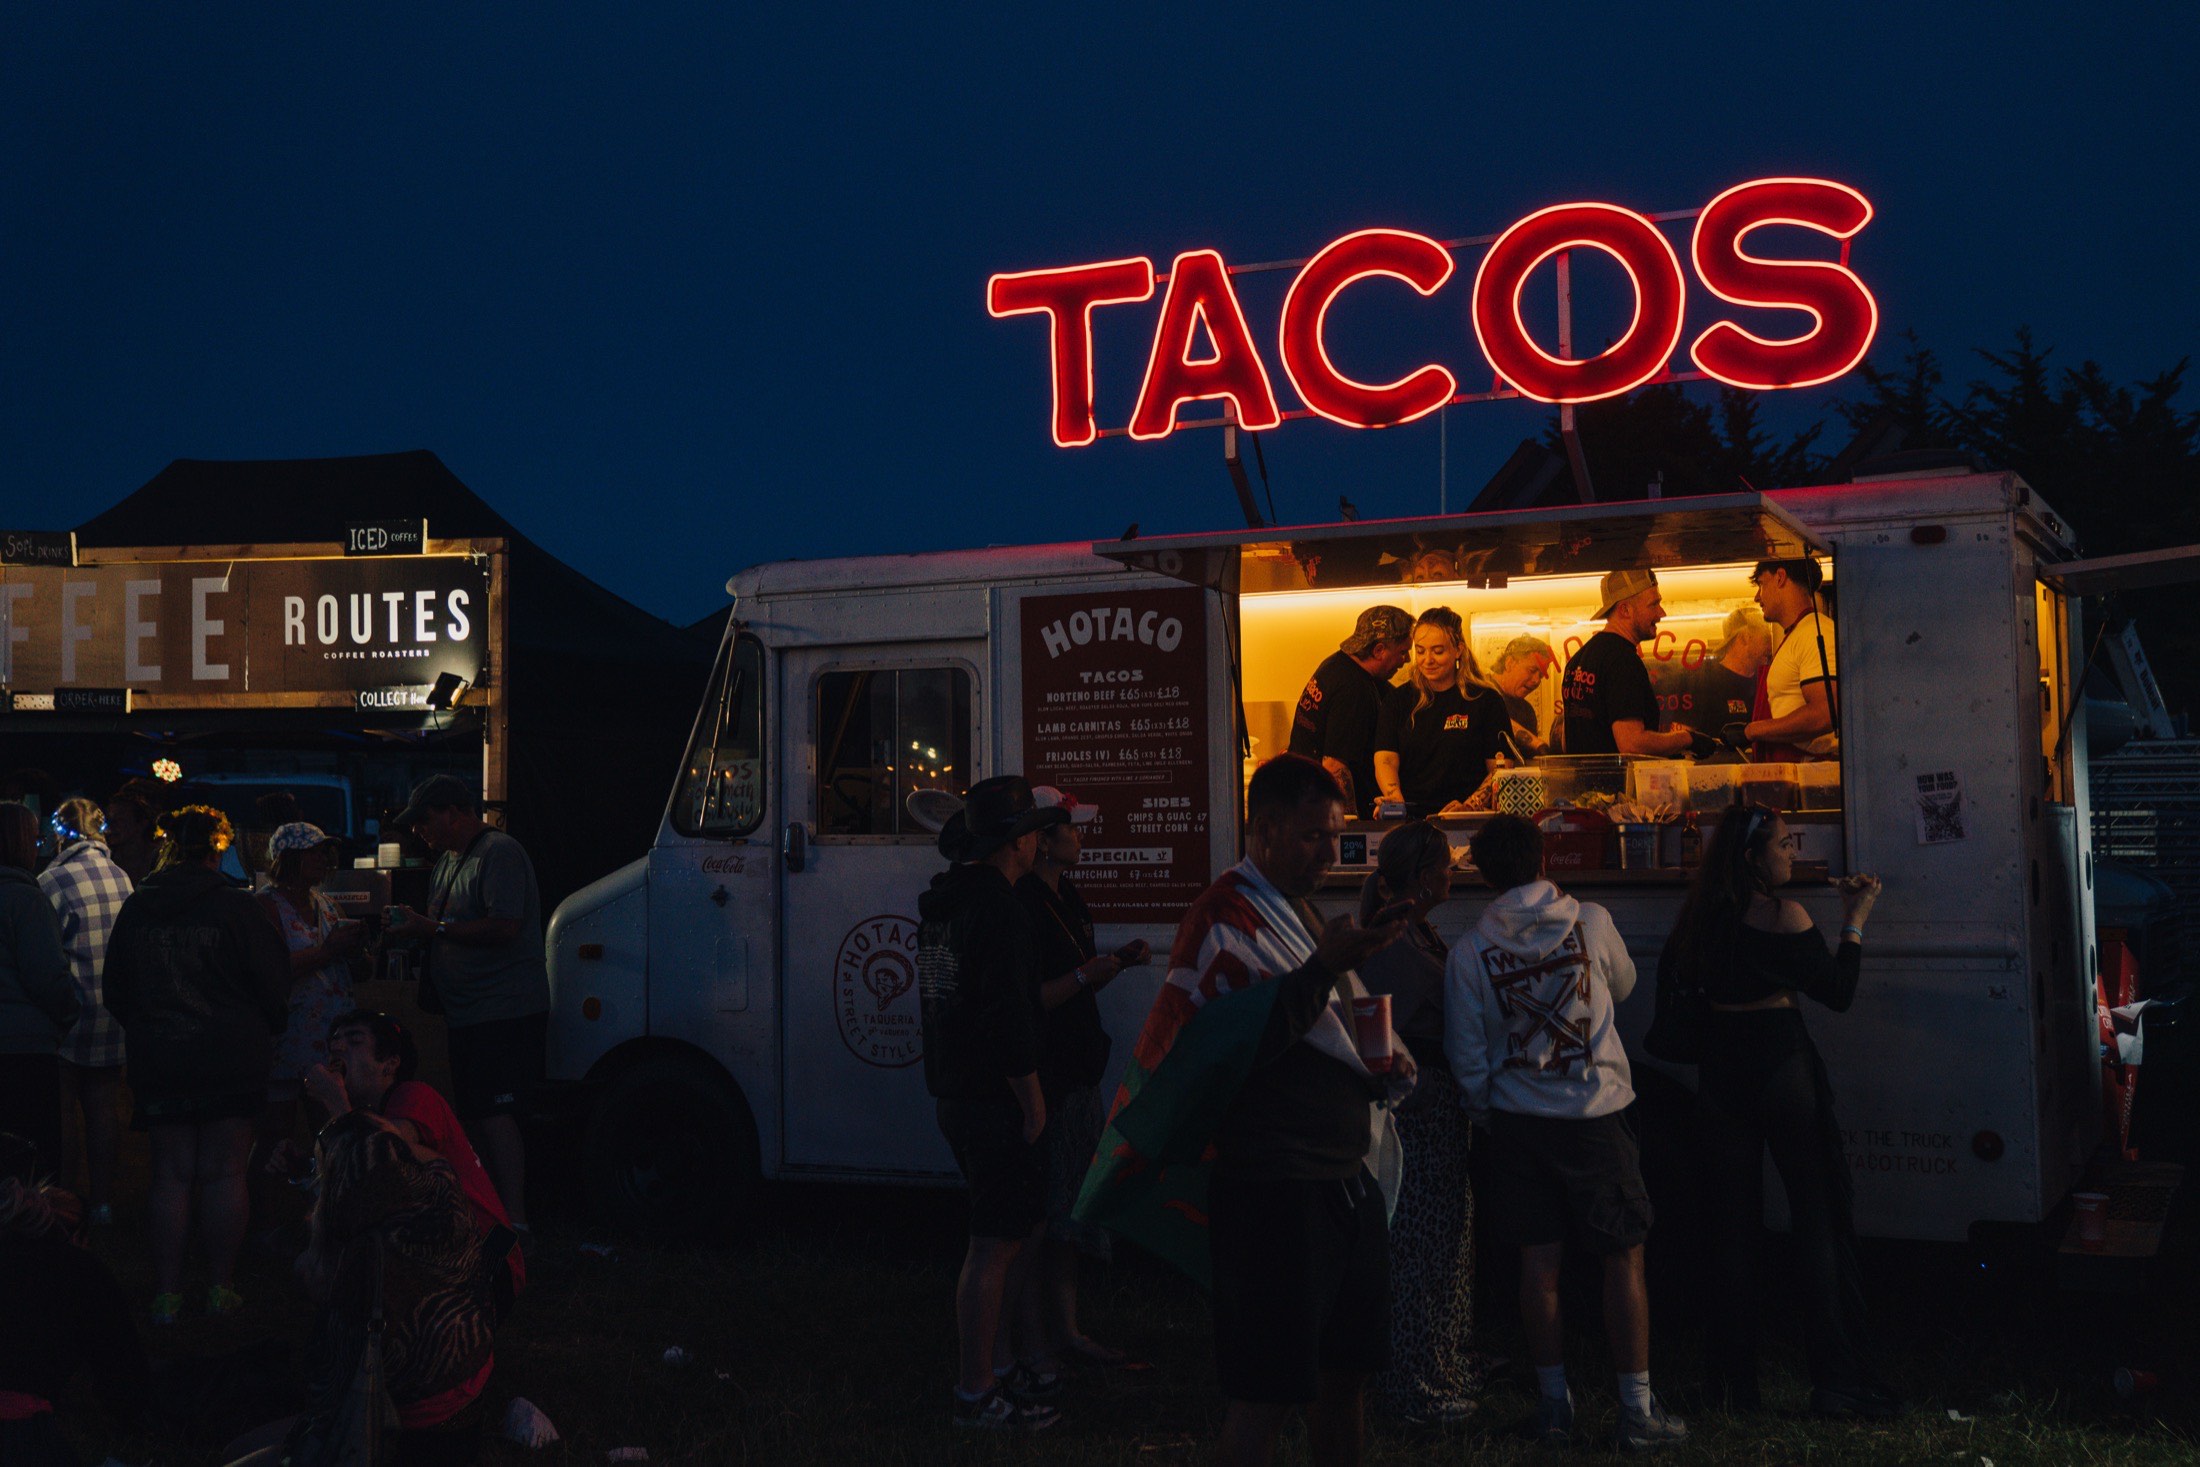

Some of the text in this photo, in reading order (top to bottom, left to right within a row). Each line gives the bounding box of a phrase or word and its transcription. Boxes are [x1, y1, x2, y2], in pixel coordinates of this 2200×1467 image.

[987, 177, 1877, 447] TACOS
[351, 528, 388, 551] ICED
[285, 588, 470, 646] ROUTES
[1040, 607, 1183, 660] HOTACO
[324, 649, 430, 660] COFFEE ROASTERS
[1080, 669, 1144, 684] TACOS
[360, 690, 408, 707] COLLECT
[1094, 690, 1116, 702] BEEF
[1037, 723, 1066, 734] LAMB
[1070, 720, 1122, 733] CARNITAS
[1167, 717, 1191, 729] £18
[1046, 750, 1092, 763] FRIJOLES
[1936, 771, 1955, 782] WAS
[1142, 796, 1191, 809] SIDES
[1127, 813, 1154, 823] CHIPS
[1156, 812, 1164, 822] &
[1167, 811, 1192, 822] GUAC
[1130, 824, 1163, 834] STREET
[1165, 823, 1188, 833] CORN
[1343, 841, 1364, 850] 20%
[1080, 851, 1149, 862] SPECIAL
[1062, 869, 1118, 880] CAMPECHANO
[864, 1014, 915, 1025] TAQUERIA
[871, 1041, 916, 1059] STYLE
[1863, 1129, 1896, 1147] THE
[1901, 1131, 1953, 1149] TRUCK
